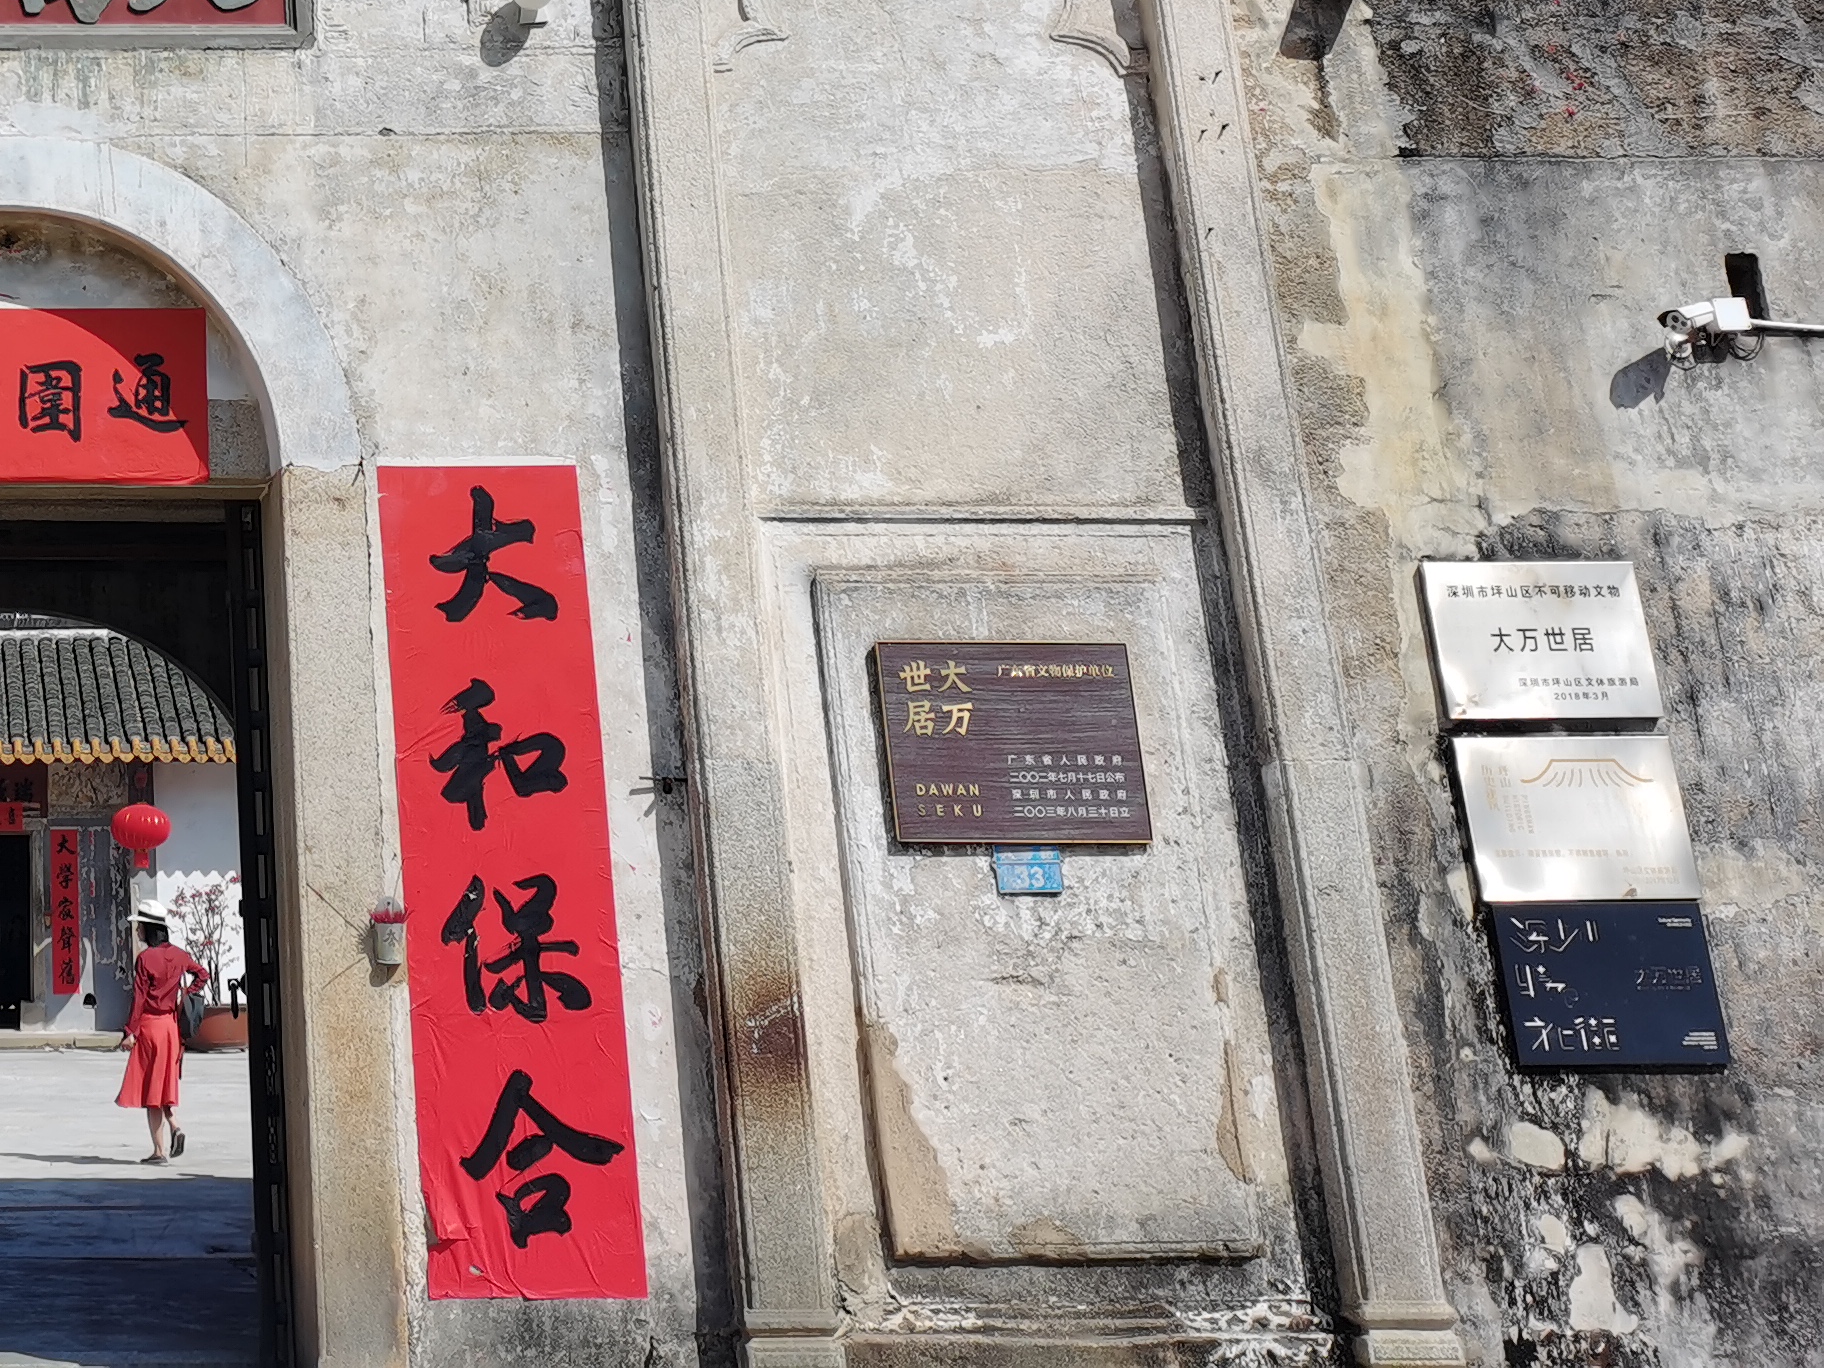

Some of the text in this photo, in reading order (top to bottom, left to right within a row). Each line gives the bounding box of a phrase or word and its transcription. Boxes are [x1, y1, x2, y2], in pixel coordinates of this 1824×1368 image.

[1446, 584, 1621, 599] 深圳市坪山区不可移动文物
[1490, 626, 1594, 653] 大万世居
[997, 663, 1115, 679] 广东省文物保护单位
[1554, 690, 1610, 701] 2018年3月
[1007, 753, 1123, 767] 广东省人民政府
[916, 783, 980, 797] DAWAN
[1012, 788, 1127, 801] 深圳市人民政府
[918, 804, 984, 817] SEKU
[428, 484, 626, 1250] 大和保合
